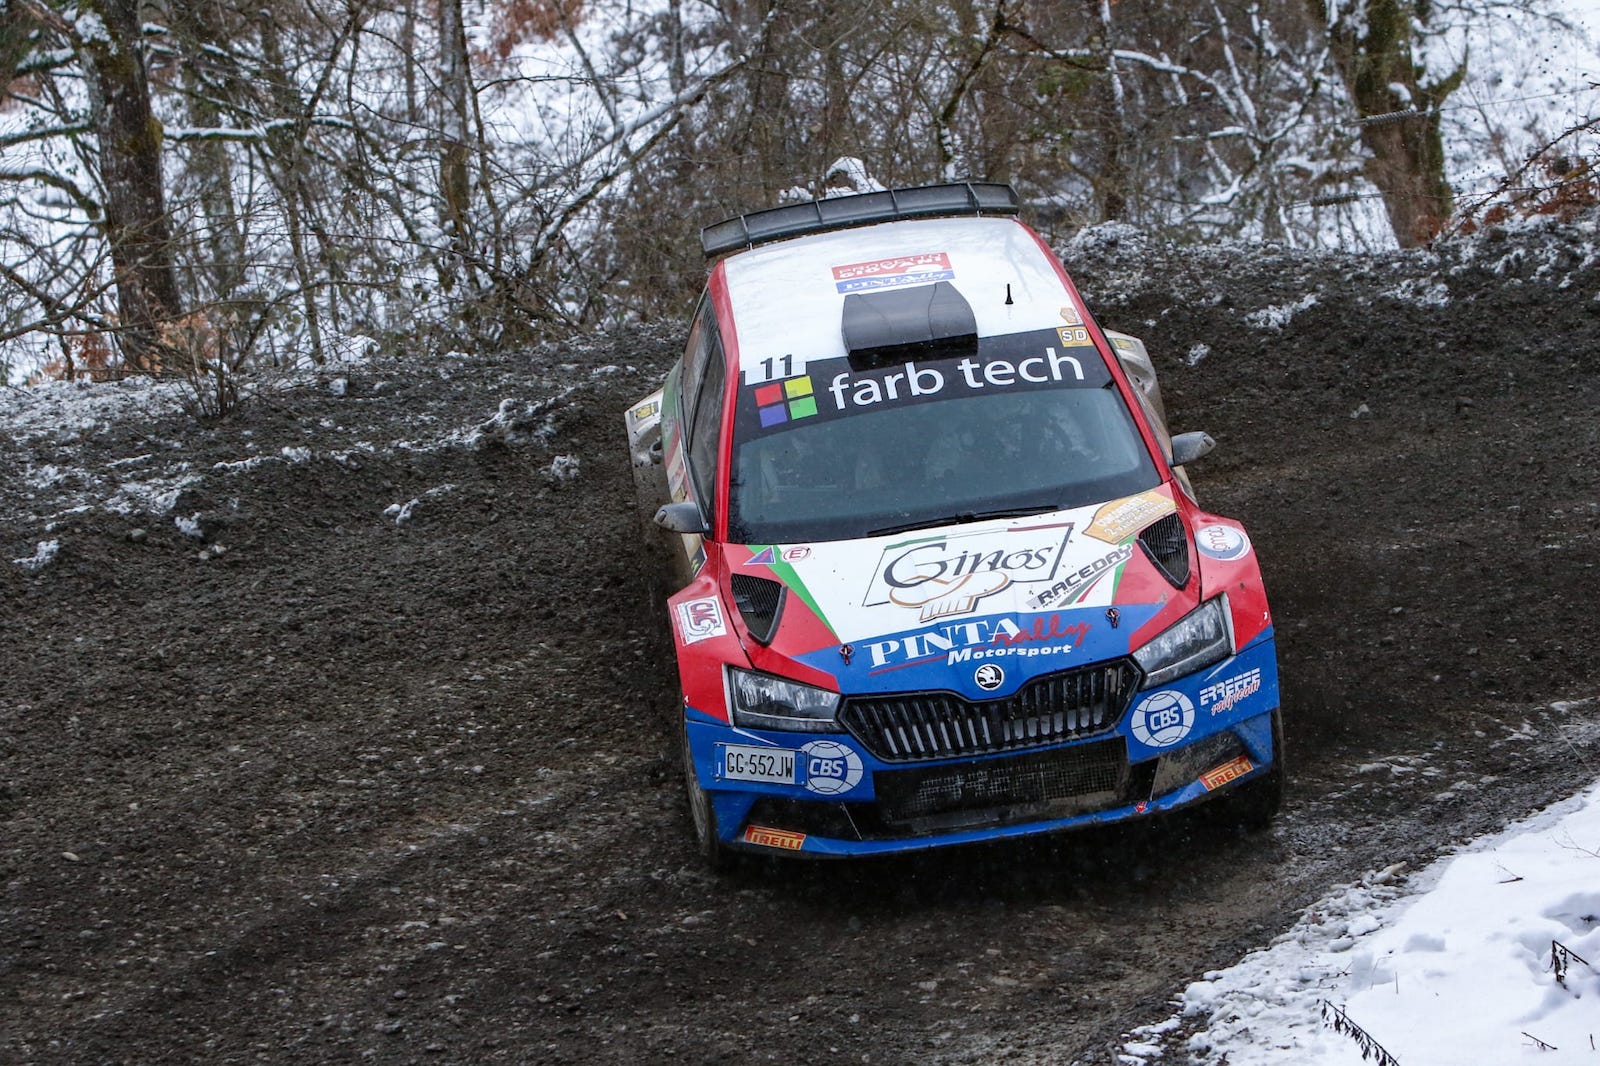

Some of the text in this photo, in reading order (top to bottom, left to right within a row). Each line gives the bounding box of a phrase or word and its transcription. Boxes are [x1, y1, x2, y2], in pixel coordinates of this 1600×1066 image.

[1061, 329, 1087, 342] SD
[760, 354, 792, 379] 11
[828, 347, 1085, 410] farb tech
[1037, 545, 1131, 605] RACEDAY
[863, 614, 1093, 669] PINTA rally
[948, 644, 1072, 665] Motorsport
[1150, 706, 1180, 731] CBS
[727, 752, 793, 777] GG 552JW
[809, 758, 844, 777] CBS
[745, 825, 806, 851] PIRELLI
